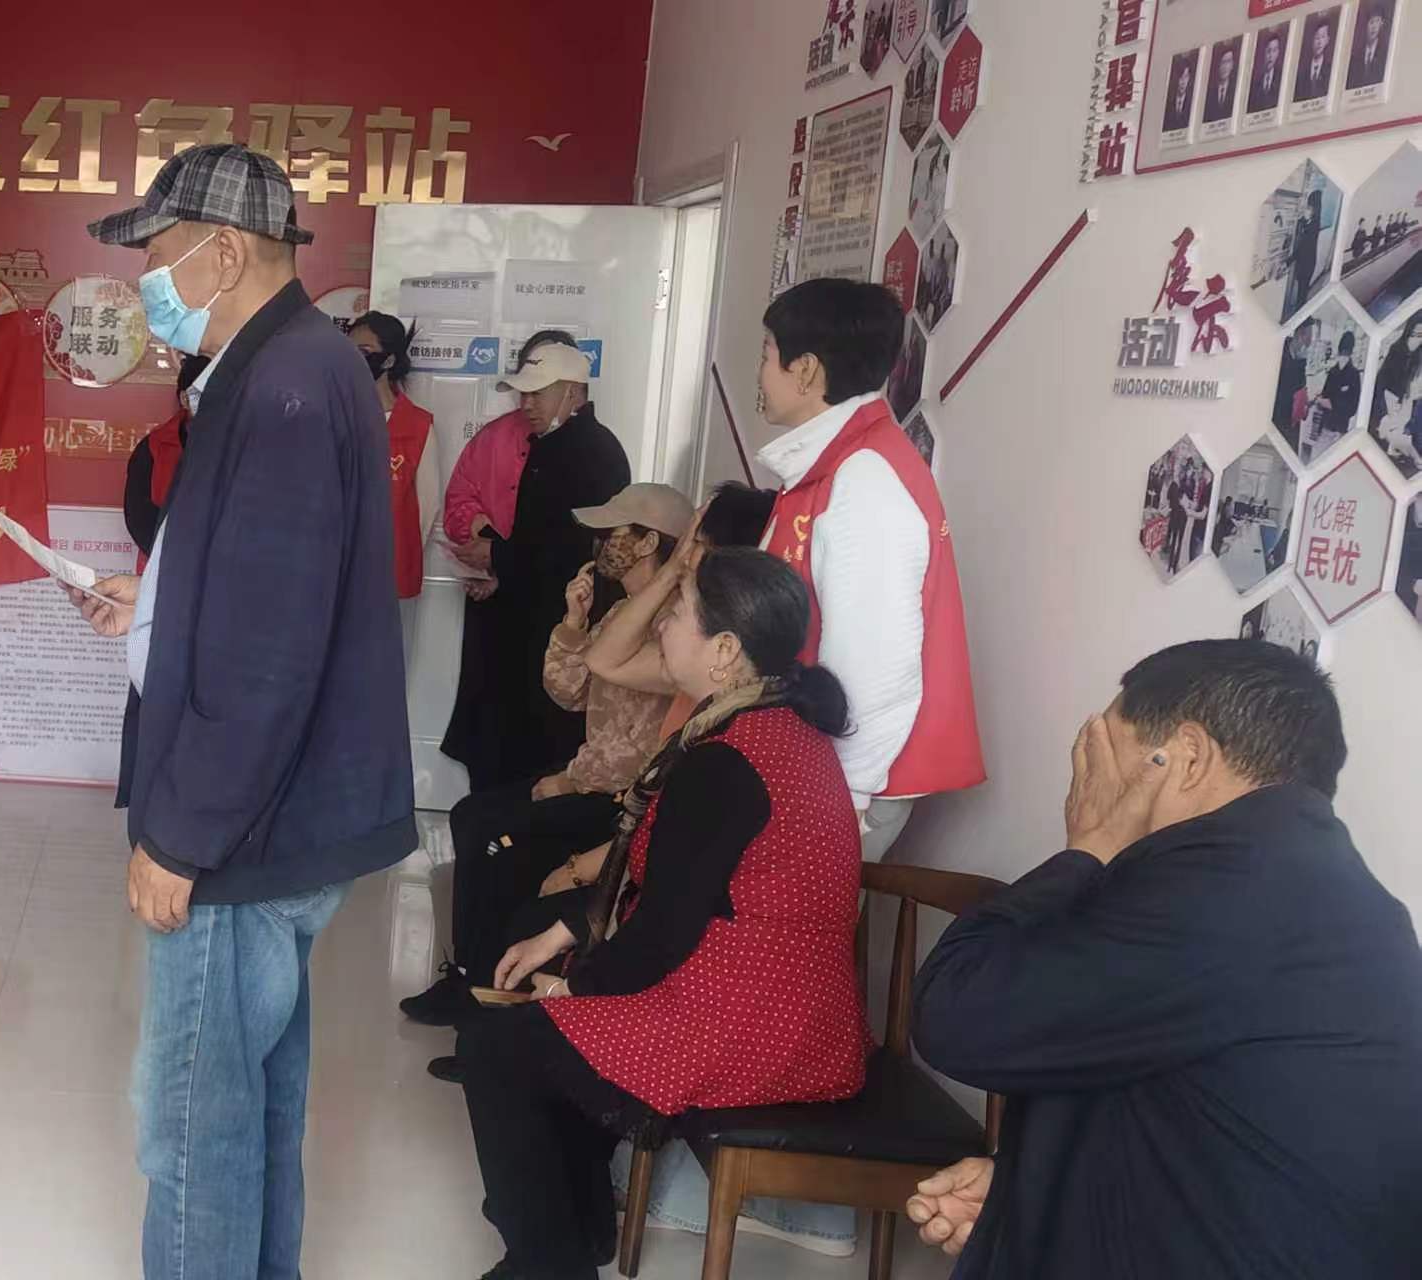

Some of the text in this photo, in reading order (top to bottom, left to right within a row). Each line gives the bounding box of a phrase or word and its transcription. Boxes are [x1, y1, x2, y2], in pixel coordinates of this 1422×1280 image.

[515, 284, 587, 296] 就业心理咨询室
[71, 305, 122, 328] 服务
[69, 333, 120, 358] 联动
[409, 346, 463, 358] 信访接待室
[1117, 316, 1180, 368] 活动
[1113, 378, 1219, 400] HUODONGZHANSHI
[1313, 494, 1358, 535] 化解
[1304, 536, 1361, 586] 民忧
